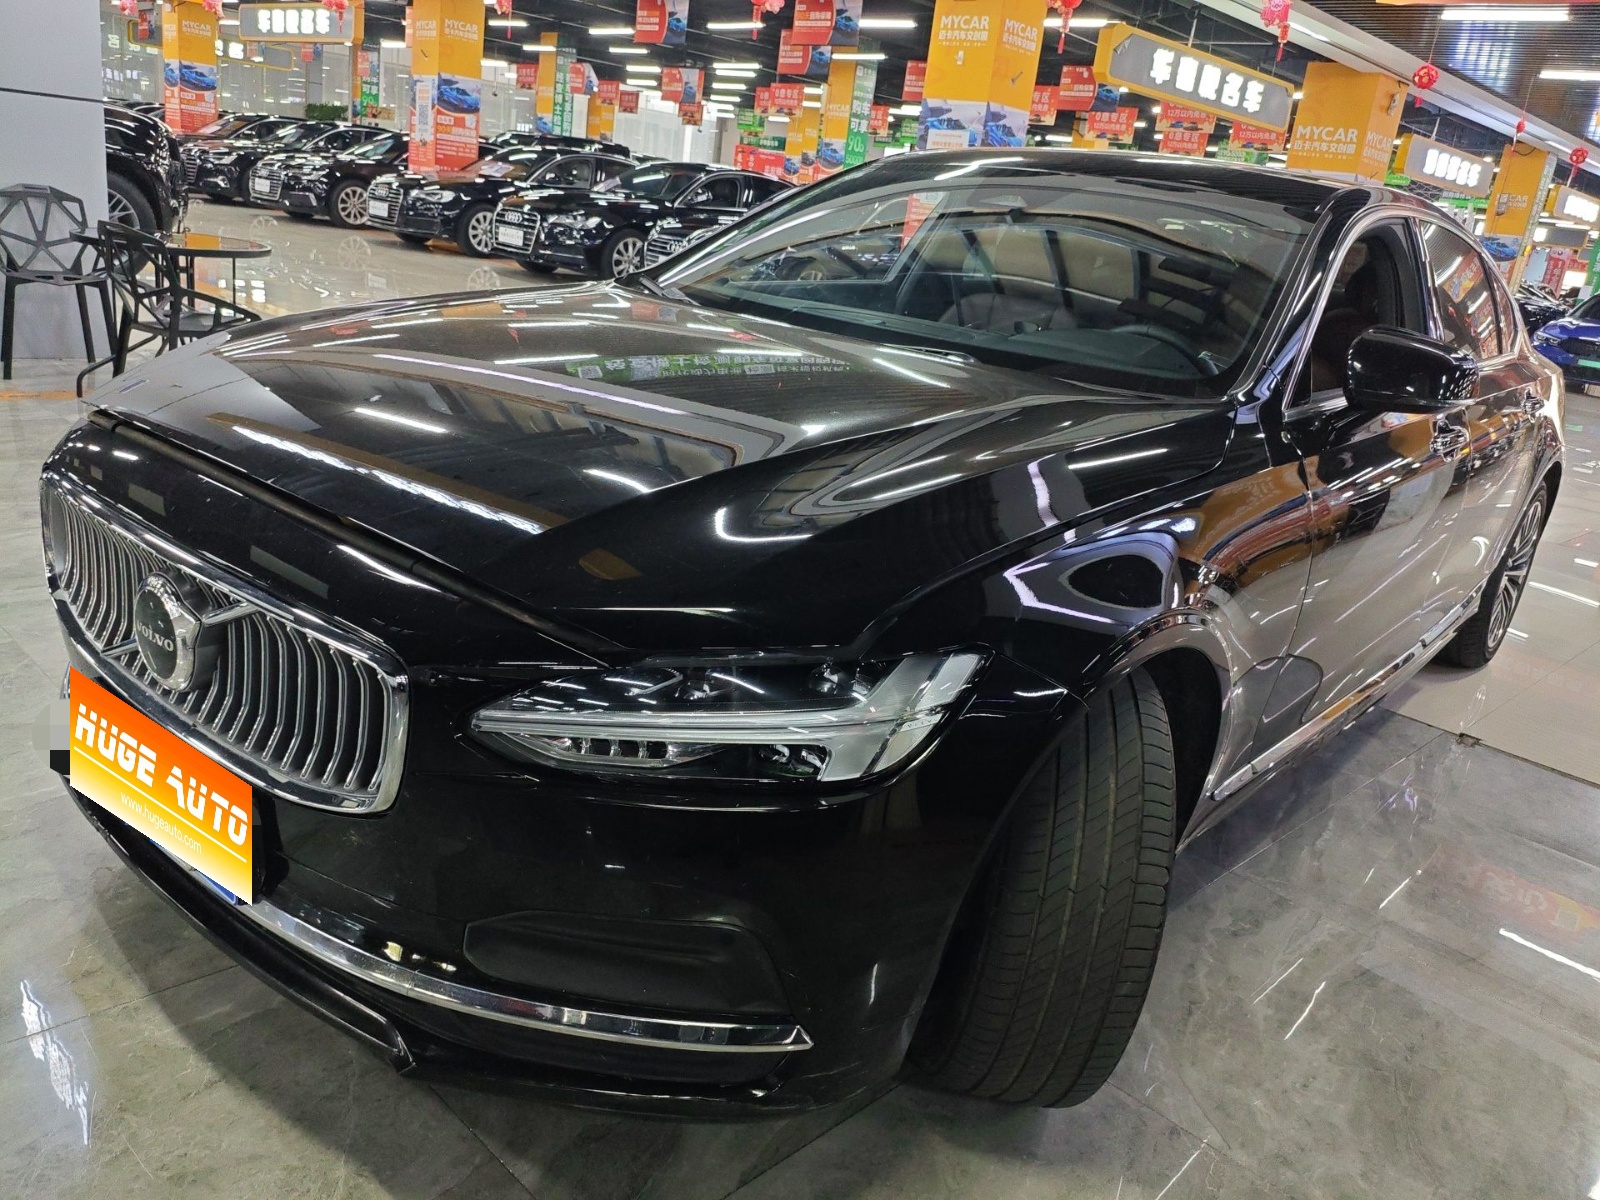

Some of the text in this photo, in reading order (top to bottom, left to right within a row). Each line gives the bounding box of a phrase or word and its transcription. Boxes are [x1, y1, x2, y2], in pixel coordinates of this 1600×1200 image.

[182, 20, 212, 32] MYCAR
[415, 20, 437, 30] MYCAR
[444, 18, 478, 33] MYCAR
[940, 15, 989, 30] MYCAR
[1005, 18, 1038, 42] MYCAR
[1033, 91, 1051, 104] 专区
[852, 100, 871, 116] 购车
[851, 118, 868, 133] 可享
[1296, 125, 1359, 143] MYCAR
[1366, 131, 1393, 152] MYCAR
[1293, 140, 1357, 154] 迈卡汽车文创园
[134, 621, 174, 653] VOLVO
